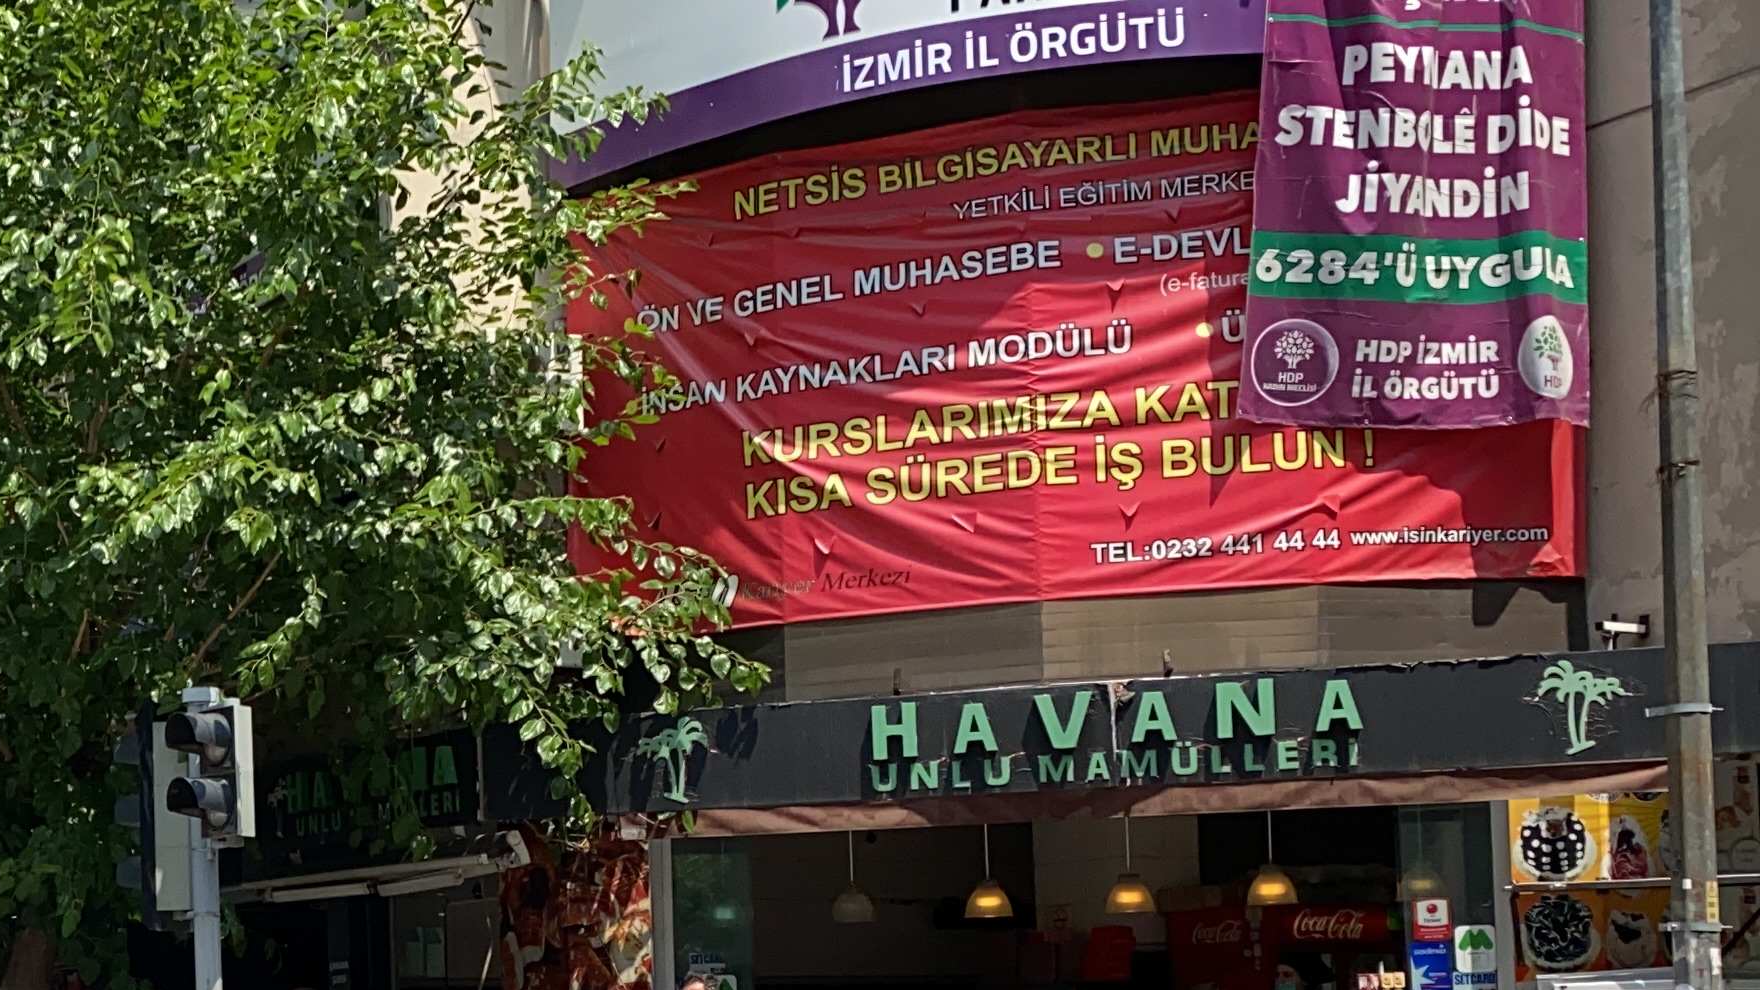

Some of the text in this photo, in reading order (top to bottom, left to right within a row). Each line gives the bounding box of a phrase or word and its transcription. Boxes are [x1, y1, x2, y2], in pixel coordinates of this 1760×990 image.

[842, 7, 1185, 92] İZMİR İL ÖRGÜTÜ
[1274, 95, 1570, 156] STENBOLÊ DİDE
[734, 121, 1259, 222] NETSİS BİLGİSAYARLI MUHA
[953, 171, 1255, 222] YETKİLİ EĞİTİM MERKE
[1335, 160, 1530, 218] JİYANDİN
[687, 296, 724, 326] VE
[734, 275, 843, 318] GENEL
[853, 240, 1061, 296] MUHASEBE
[1114, 227, 1250, 264] E-DEVL
[1256, 242, 1575, 290] 6284'Ü UYGULA
[641, 379, 726, 415] İNSAN
[736, 345, 955, 402] KAYNAKLARI
[967, 318, 1133, 368] MODÜLÜ
[1277, 372, 1304, 383] HDP
[1356, 334, 1500, 364] HDP İZMİR
[1351, 368, 1500, 399] İL ÖRGÜTÜ
[741, 380, 1239, 467] KURSLARIMIZA KAT
[745, 474, 852, 519] KISA
[865, 445, 1079, 505] SÜREDE
[1095, 435, 1143, 491] İŞ
[1162, 431, 1346, 478] BULUN
[1090, 526, 1549, 564] TEL:0232 441 44 44 www.isinkariyer.com
[821, 564, 912, 593] Merkezi
[870, 677, 1364, 761] HAVANA
